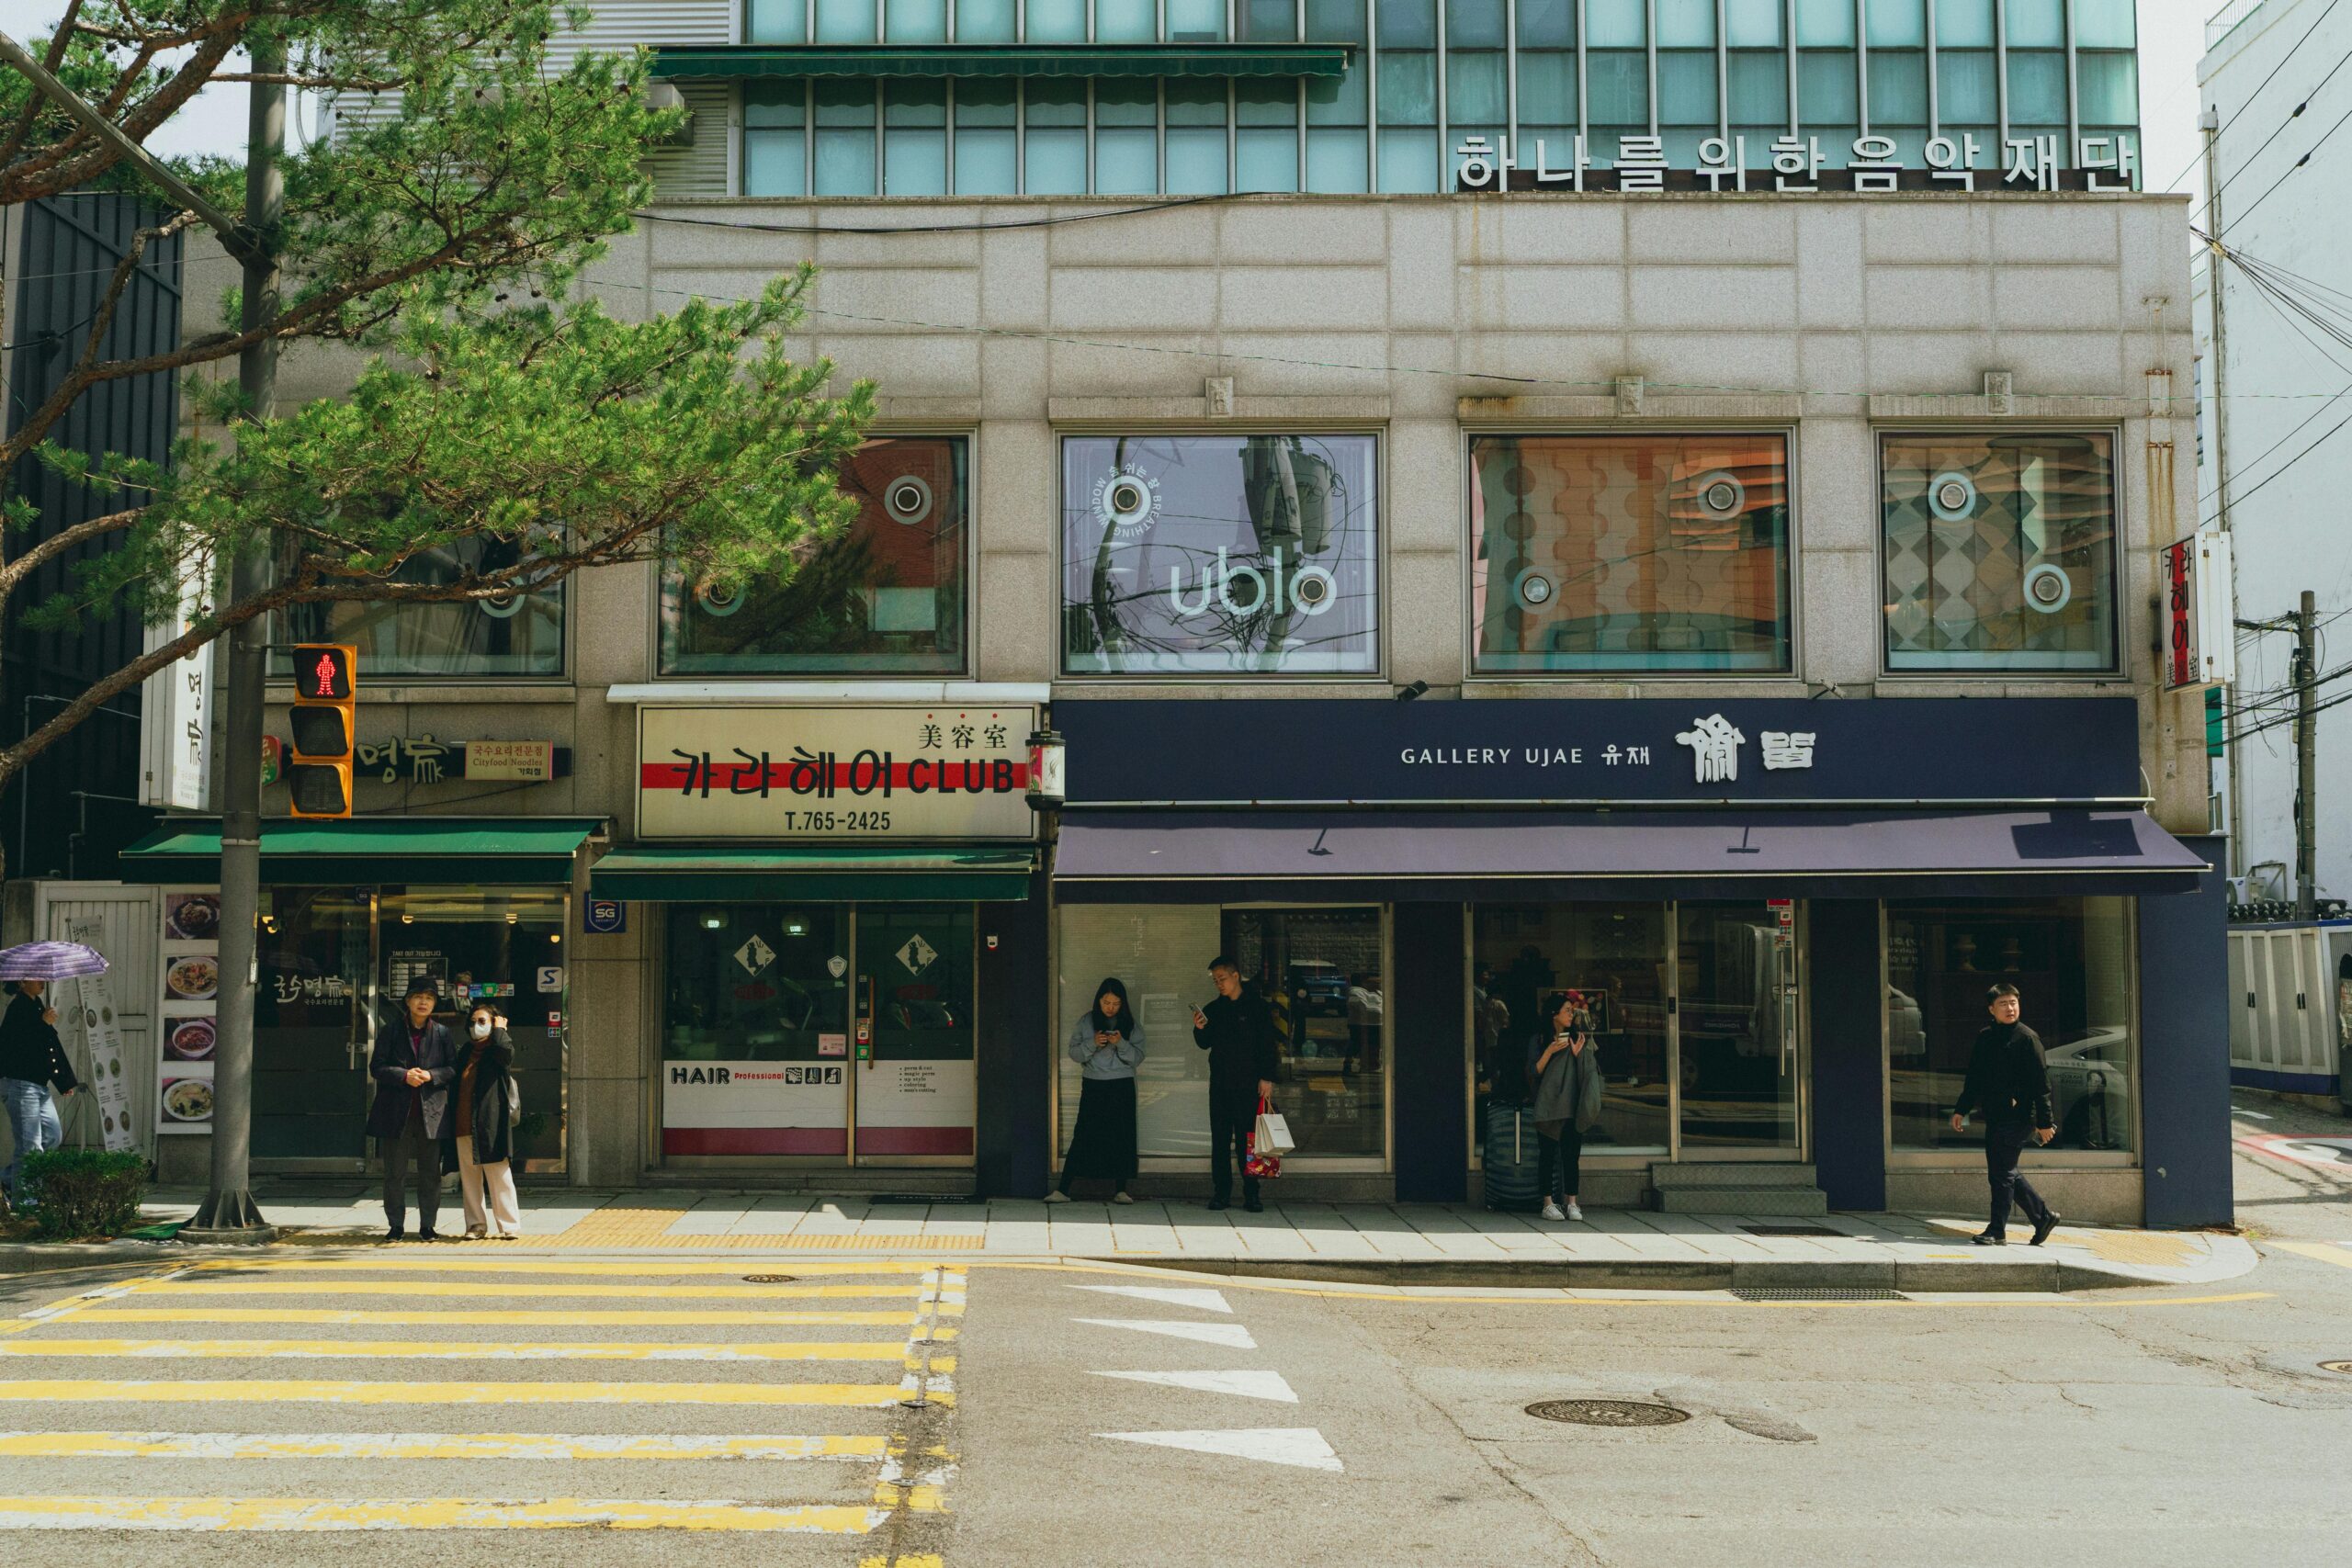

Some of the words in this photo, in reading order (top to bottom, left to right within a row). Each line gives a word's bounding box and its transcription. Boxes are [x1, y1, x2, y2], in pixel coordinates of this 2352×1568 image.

[1091, 477, 1109, 529] WINDOW
[1114, 495, 1162, 537] BREATHING
[1170, 546, 1338, 615] ublo
[919, 724, 1008, 750] 美容室
[473, 758, 508, 767] Cityfood
[511, 758, 543, 766] Noodles
[1401, 748, 1511, 764] GALLERY
[1525, 748, 1583, 767] UJAE
[1600, 744, 1650, 766] 유재
[671, 745, 892, 799] 카라헤어
[908, 758, 1014, 794] CLUB
[785, 811, 891, 831] T.765-2425
[595, 908, 616, 919] SG
[671, 1066, 730, 1085] HAIR
[734, 1072, 785, 1080] Professional
